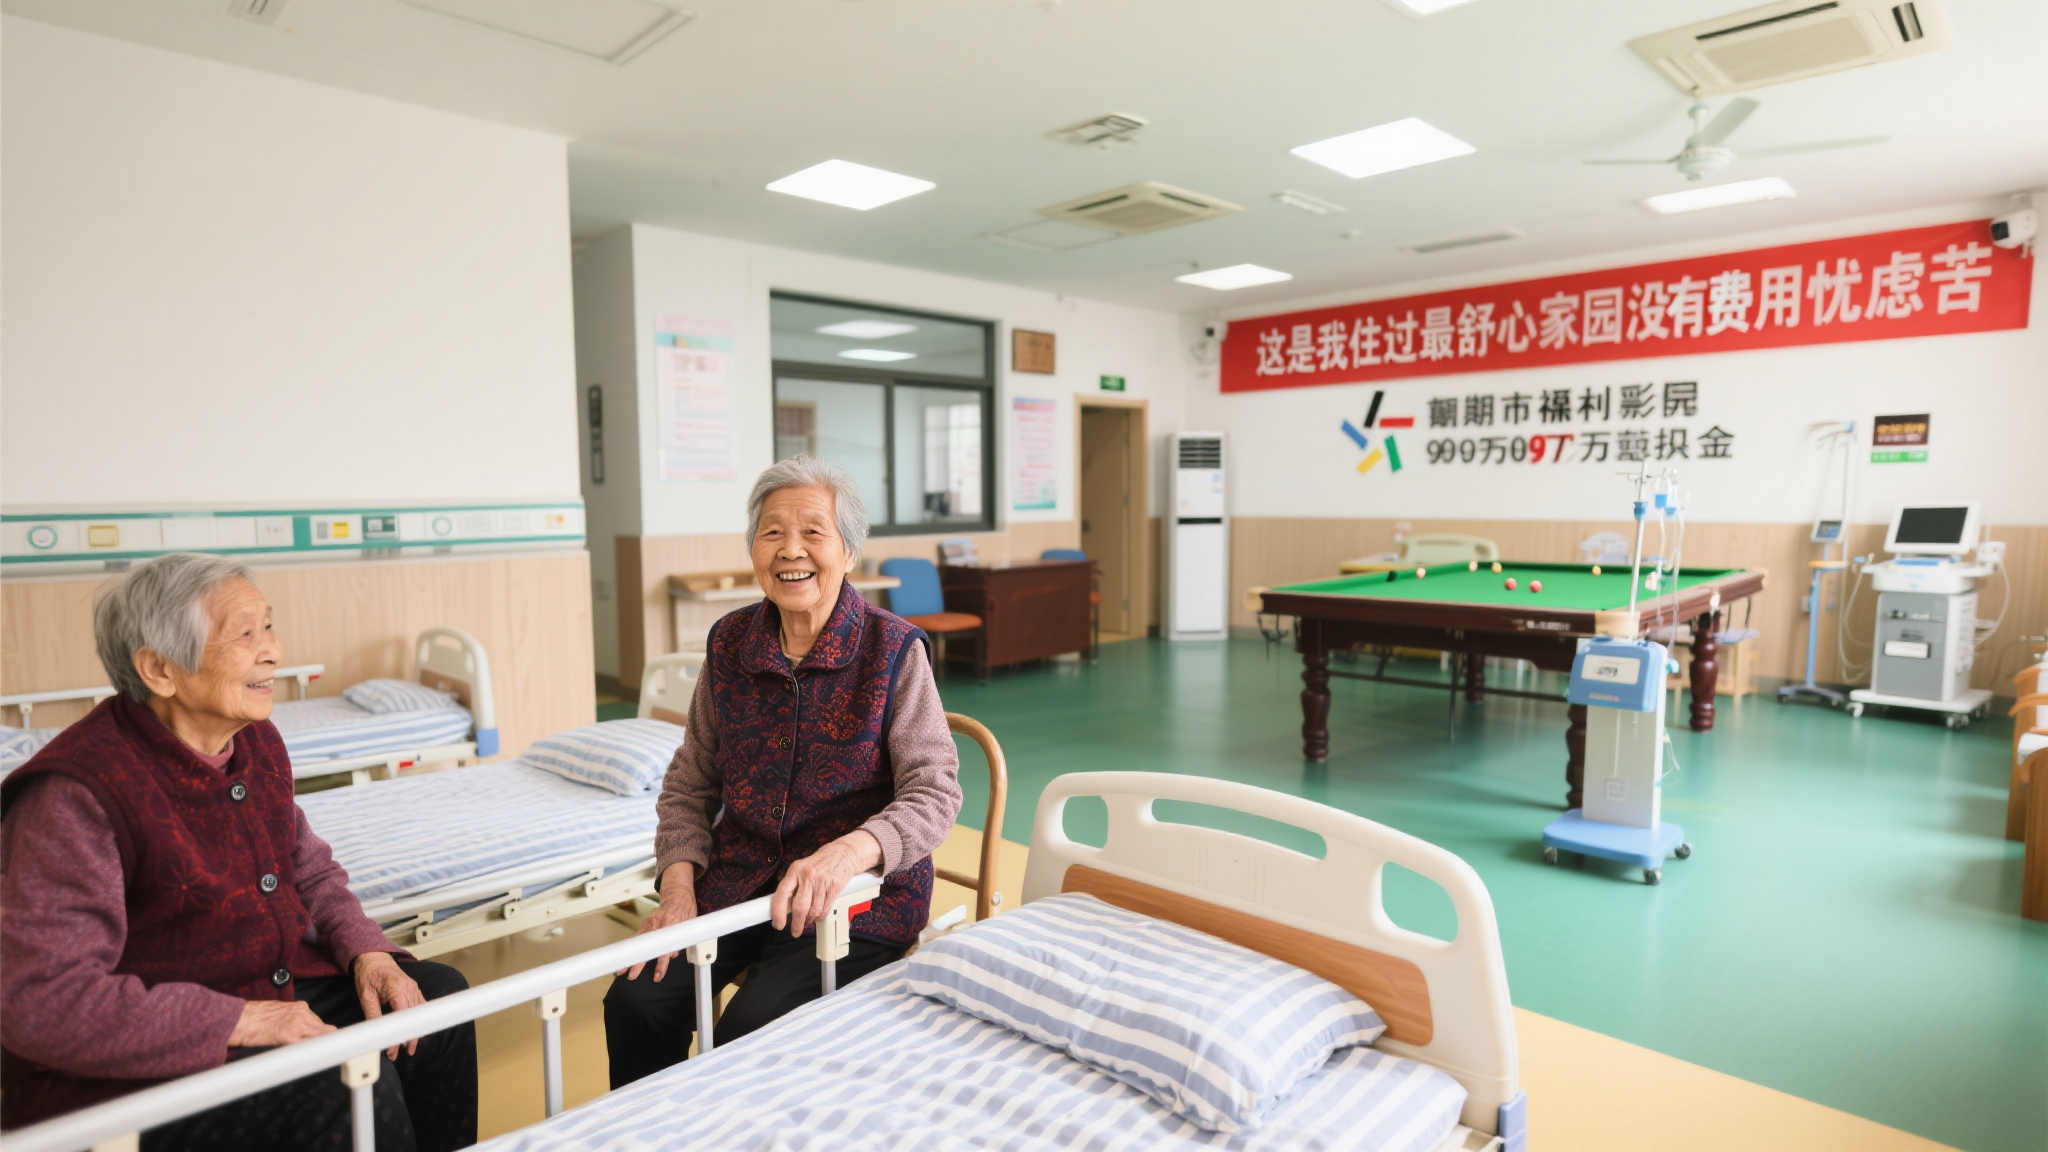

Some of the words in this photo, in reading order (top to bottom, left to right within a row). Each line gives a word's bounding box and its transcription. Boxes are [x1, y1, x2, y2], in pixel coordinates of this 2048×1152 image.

[1255, 241, 1993, 377] 这是我住过最舒心家园没有费用忧虑苦
